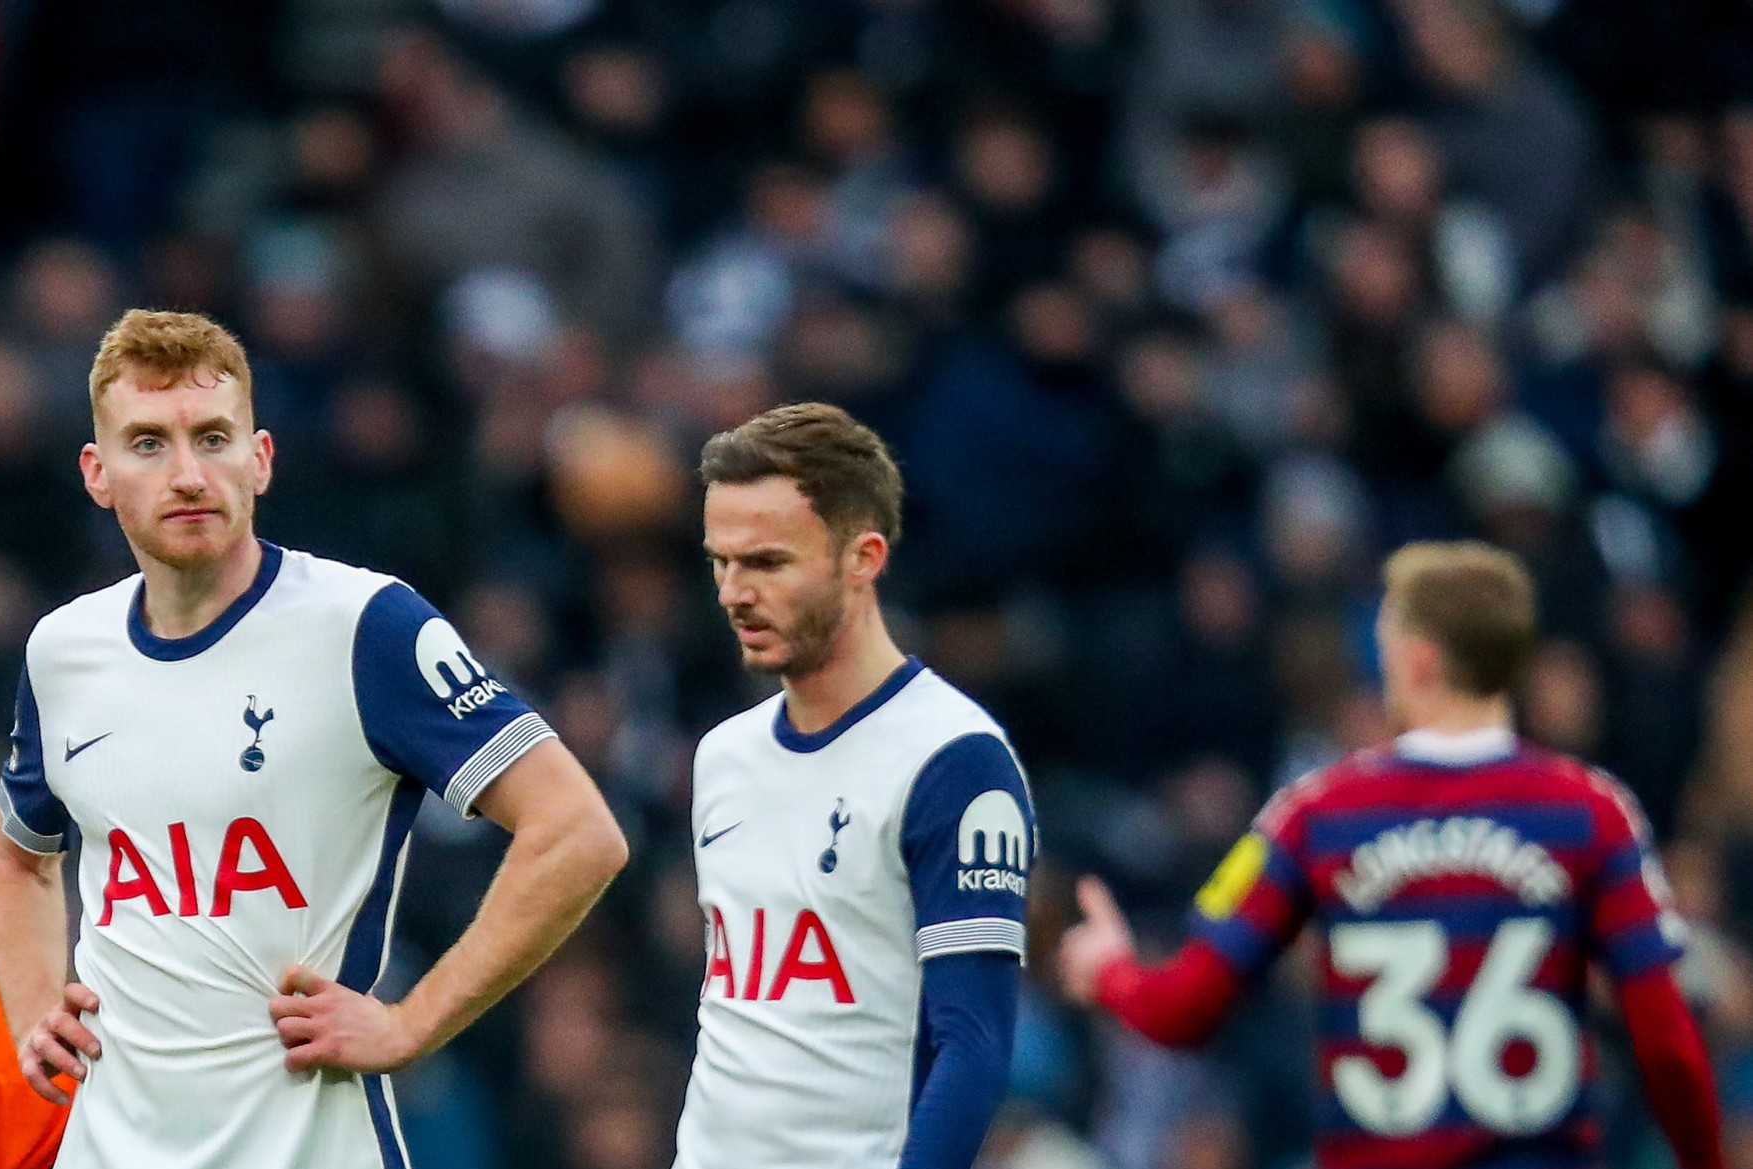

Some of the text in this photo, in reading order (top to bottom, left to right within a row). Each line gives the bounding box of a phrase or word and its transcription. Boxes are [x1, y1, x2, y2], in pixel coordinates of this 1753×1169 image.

[446, 678, 508, 720] krak
[94, 816, 309, 927] AIA
[699, 905, 857, 1004] AIA
[1329, 917, 1581, 1136] 36
